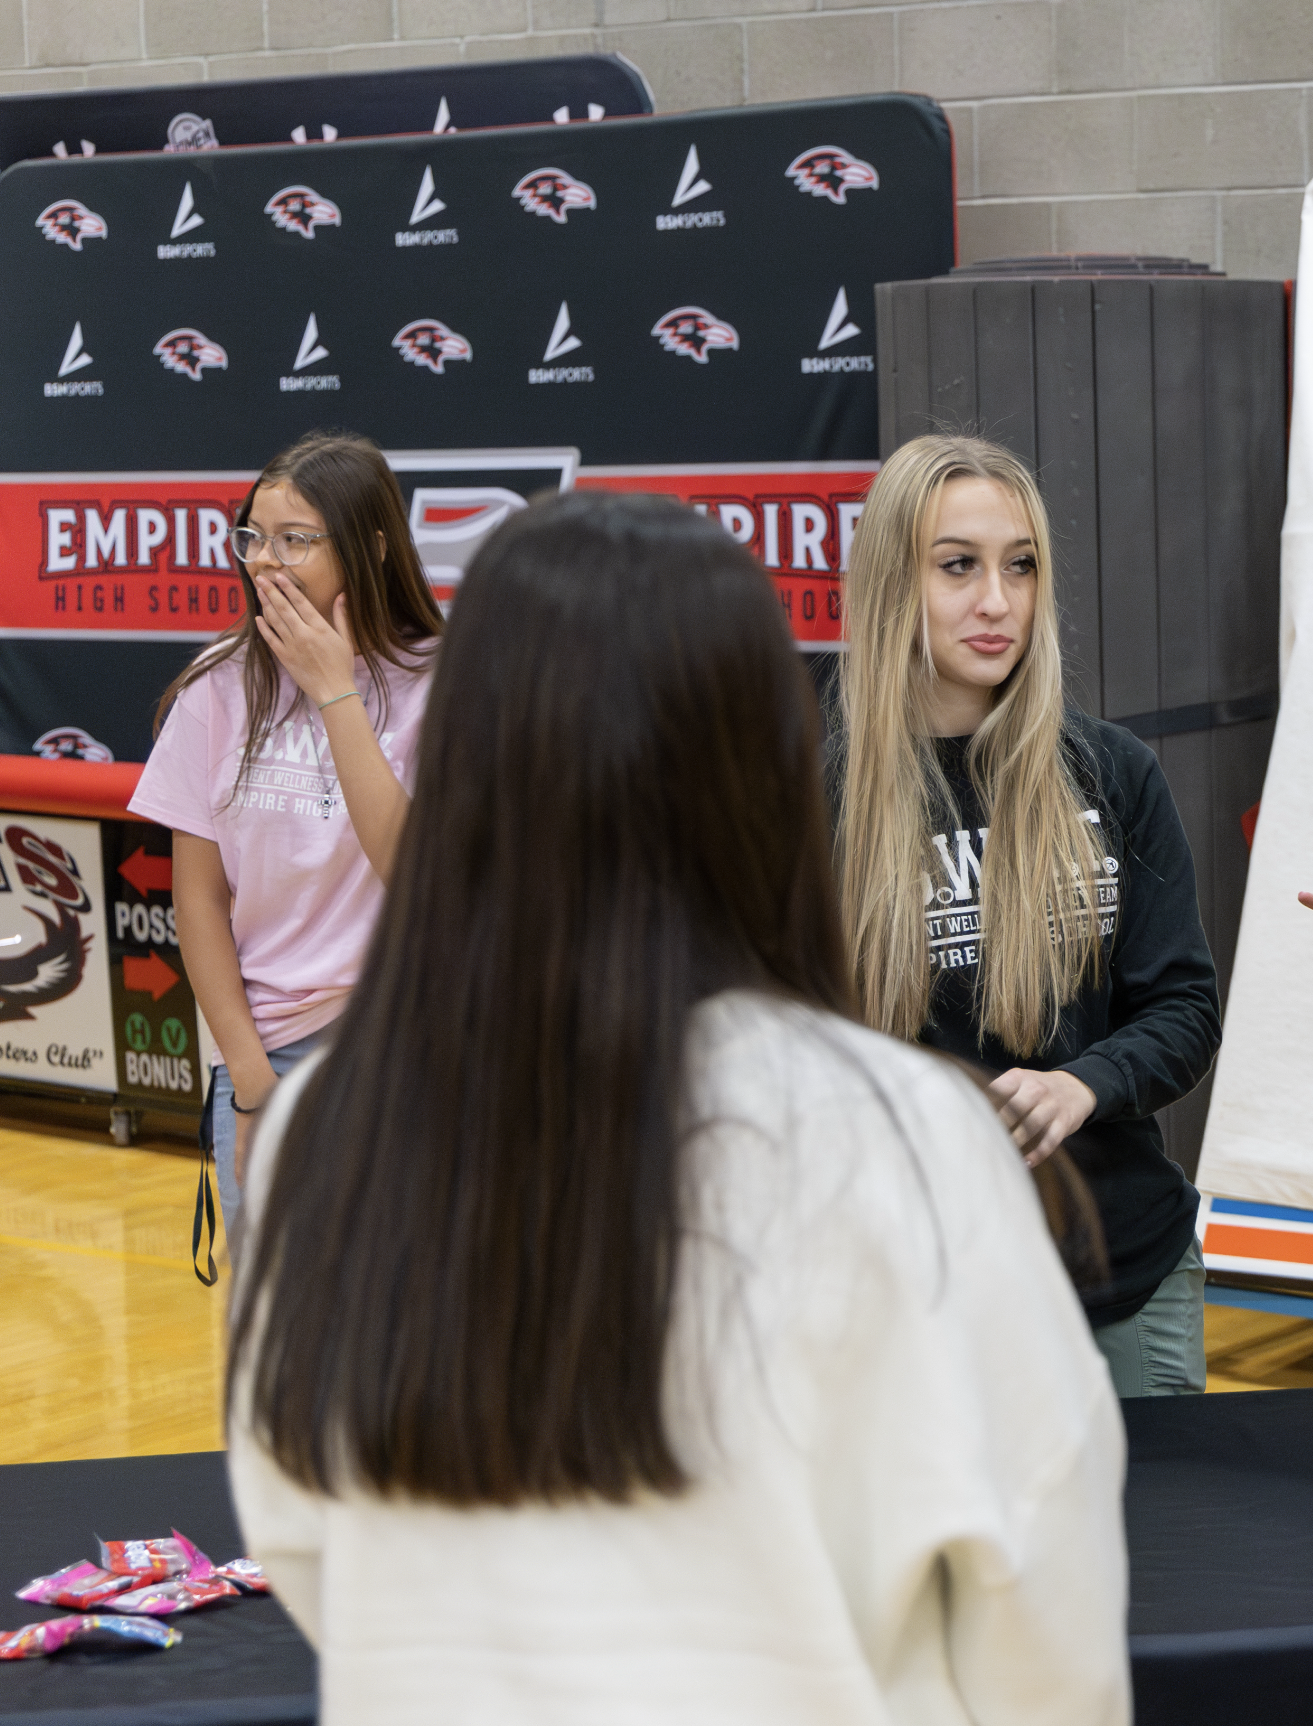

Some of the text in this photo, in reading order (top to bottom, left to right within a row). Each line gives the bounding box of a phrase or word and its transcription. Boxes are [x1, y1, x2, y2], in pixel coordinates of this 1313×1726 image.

[42, 503, 238, 577] EMPIR
[690, 500, 868, 574] PIRE
[55, 584, 241, 614] HIGH SCHOO
[274, 769, 324, 793] WELLNESS
[946, 914, 982, 934] WELL
[928, 945, 979, 969] PIRE
[125, 1050, 193, 1092] BONUS
